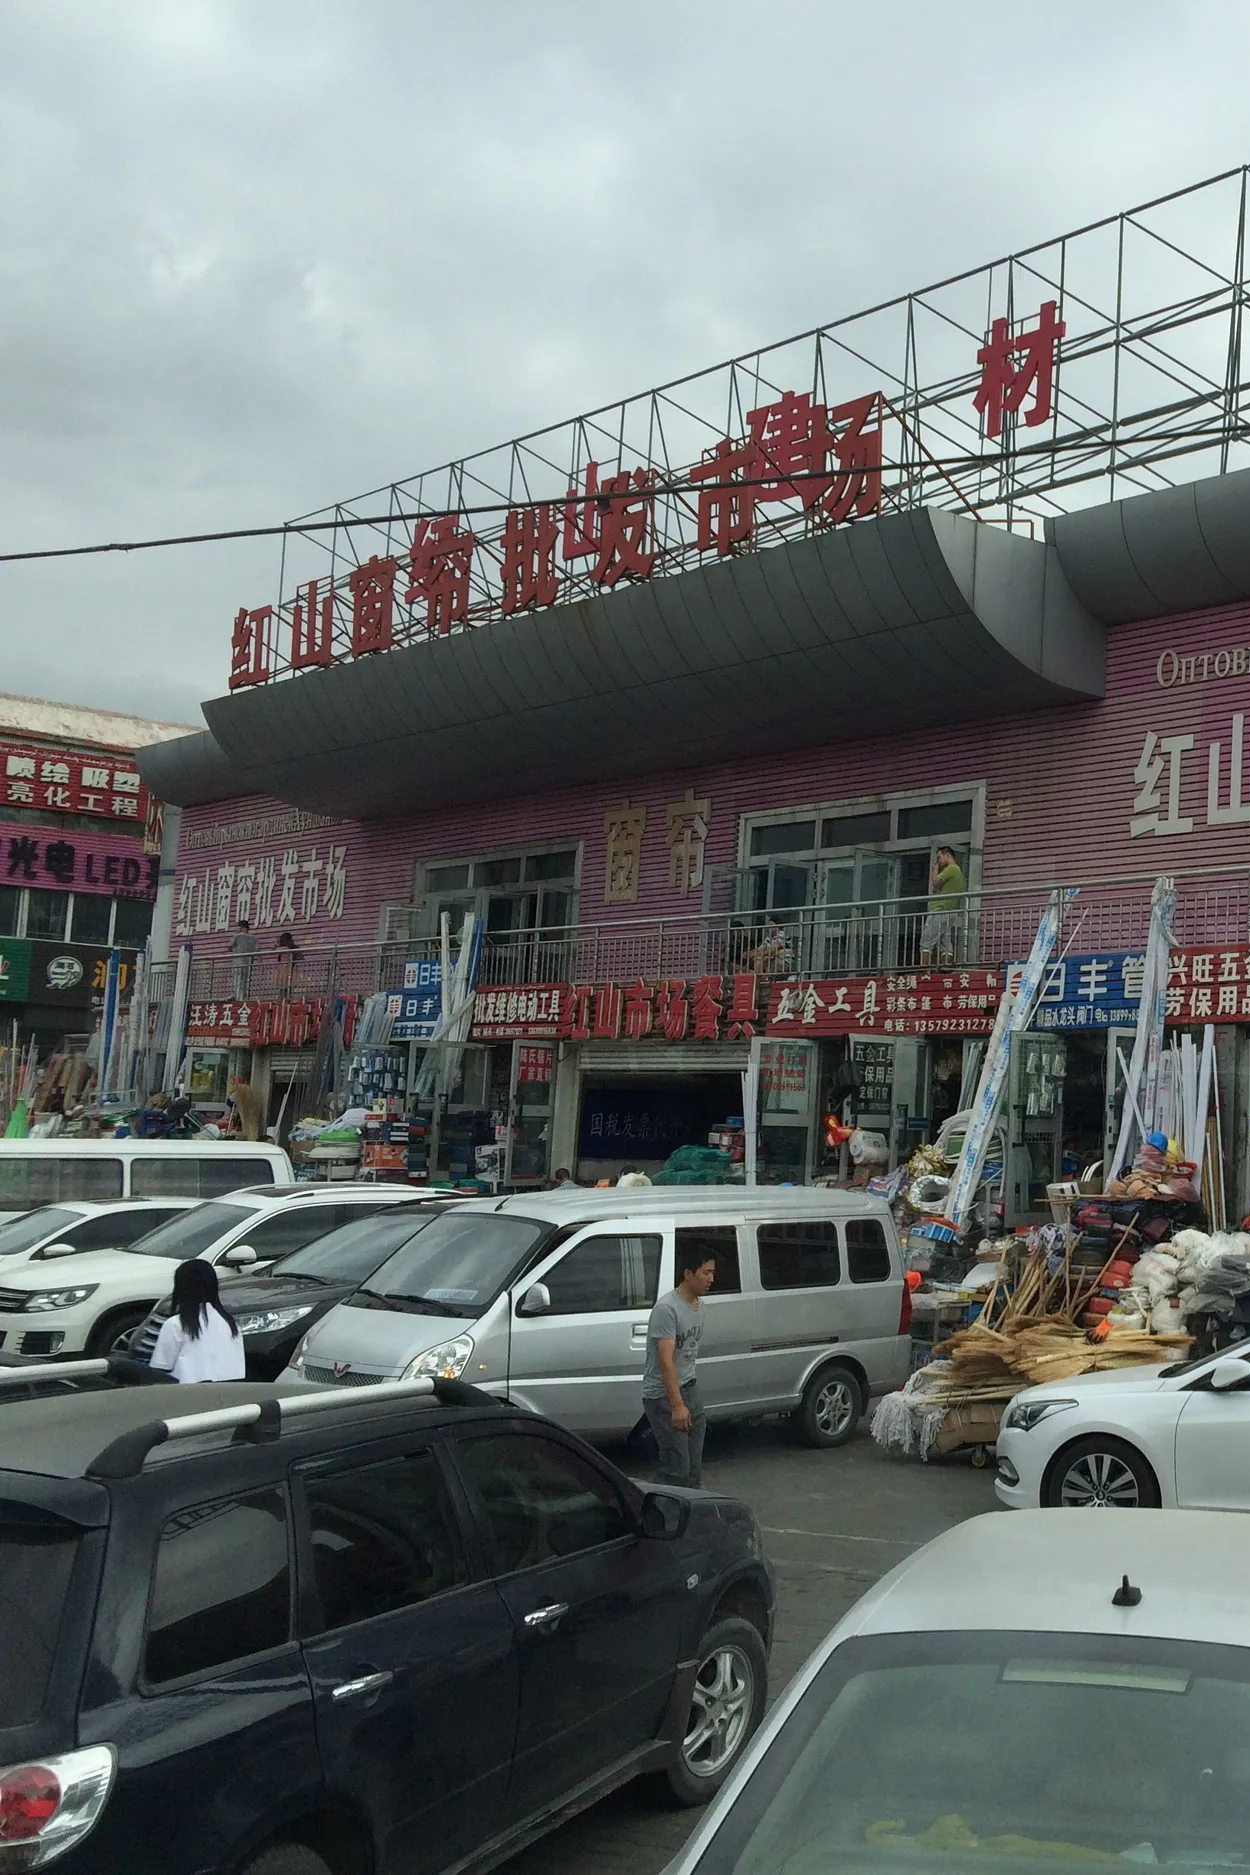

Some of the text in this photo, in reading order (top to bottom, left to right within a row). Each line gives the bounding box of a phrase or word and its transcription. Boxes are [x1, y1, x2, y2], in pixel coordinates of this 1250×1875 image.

[6, 755, 71, 785] 喷绘
[81, 766, 141, 794] 吸塑
[6, 781, 138, 818] 亮化工程
[603, 787, 712, 906] 窗帘
[175, 845, 348, 937] 红山窗帘批发市场
[473, 989, 560, 1024] 批发维修电动工具
[562, 973, 758, 1041] 红山市场餐具
[771, 980, 881, 1027] 五金工具
[855, 1045, 894, 1063] 五金工具
[859, 1064, 894, 1083] 保用品
